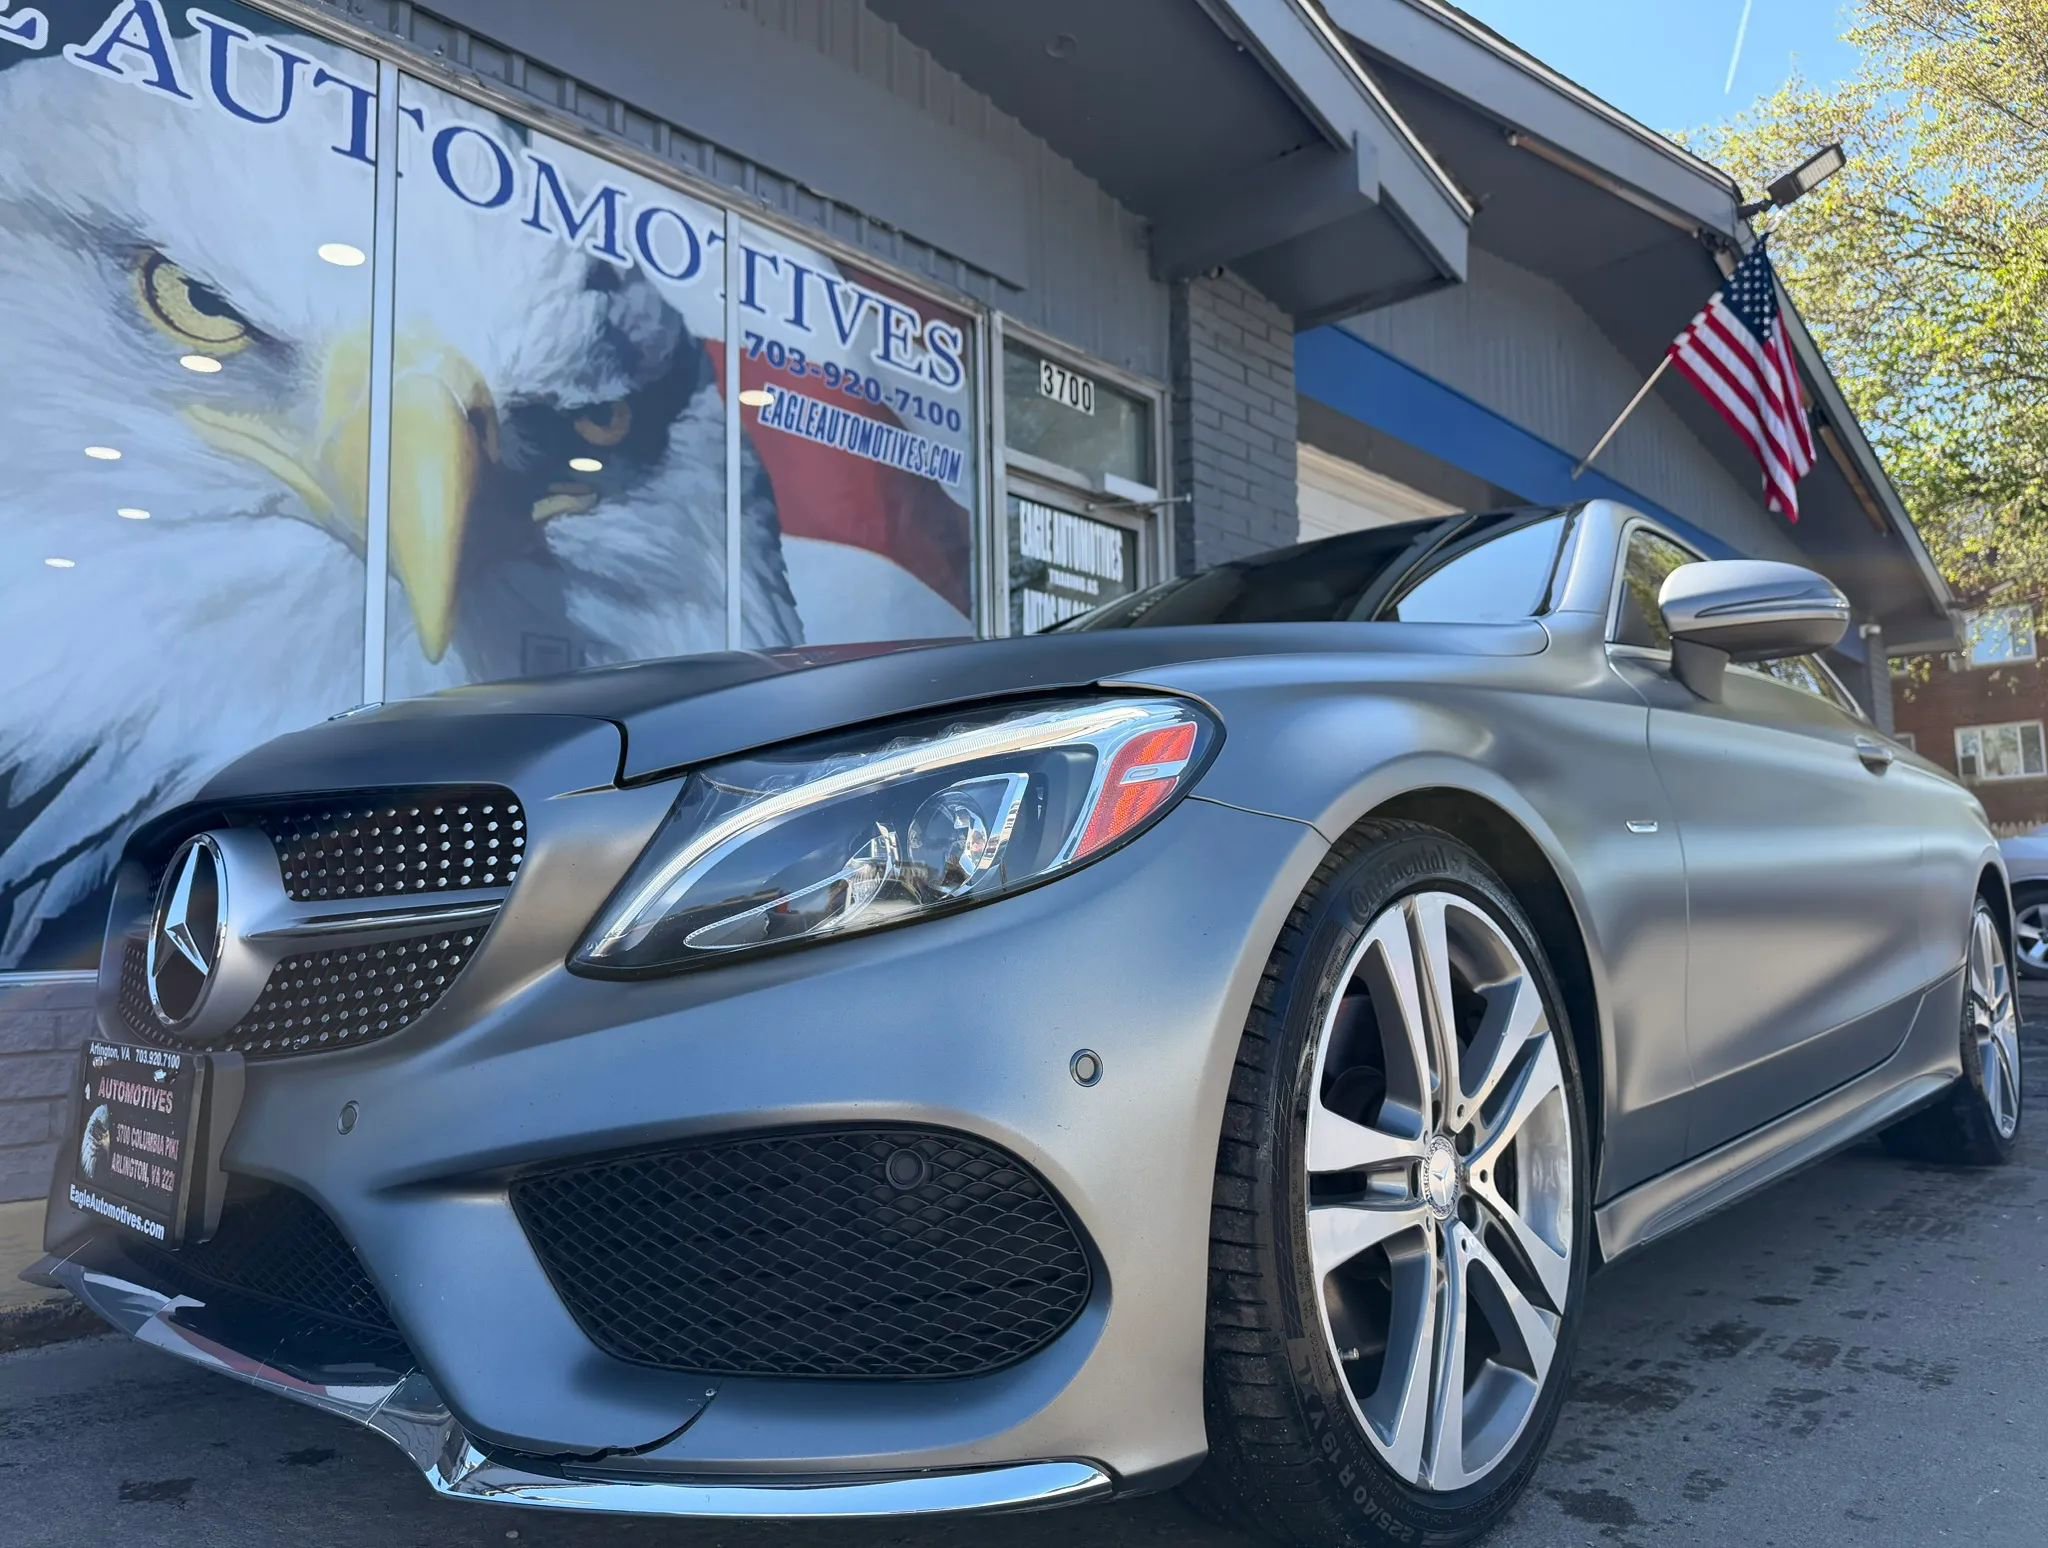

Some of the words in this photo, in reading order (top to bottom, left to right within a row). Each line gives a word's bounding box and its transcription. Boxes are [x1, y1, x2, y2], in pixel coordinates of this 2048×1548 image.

[70, 0, 965, 390] AUTOMOTIVES
[744, 330, 963, 433] 703-920-7100
[1043, 363, 1092, 412] 3700
[759, 385, 963, 486] EAGLEAUTOMOTIVES.COM
[89, 1041, 120, 1062] Arlington,
[120, 1046, 131, 1061] VA
[135, 1048, 181, 1070] 703.920.7100
[97, 1076, 175, 1115] AUTOMOTIVES
[110, 1151, 150, 1189] ARLINGTON,
[150, 1164, 161, 1187] VA
[69, 1183, 165, 1241] EagleAutomotives.com
[1320, 1431, 1342, 1464] 19
[1337, 1464, 1356, 1489] R
[1353, 1485, 1416, 1543] 225/40
